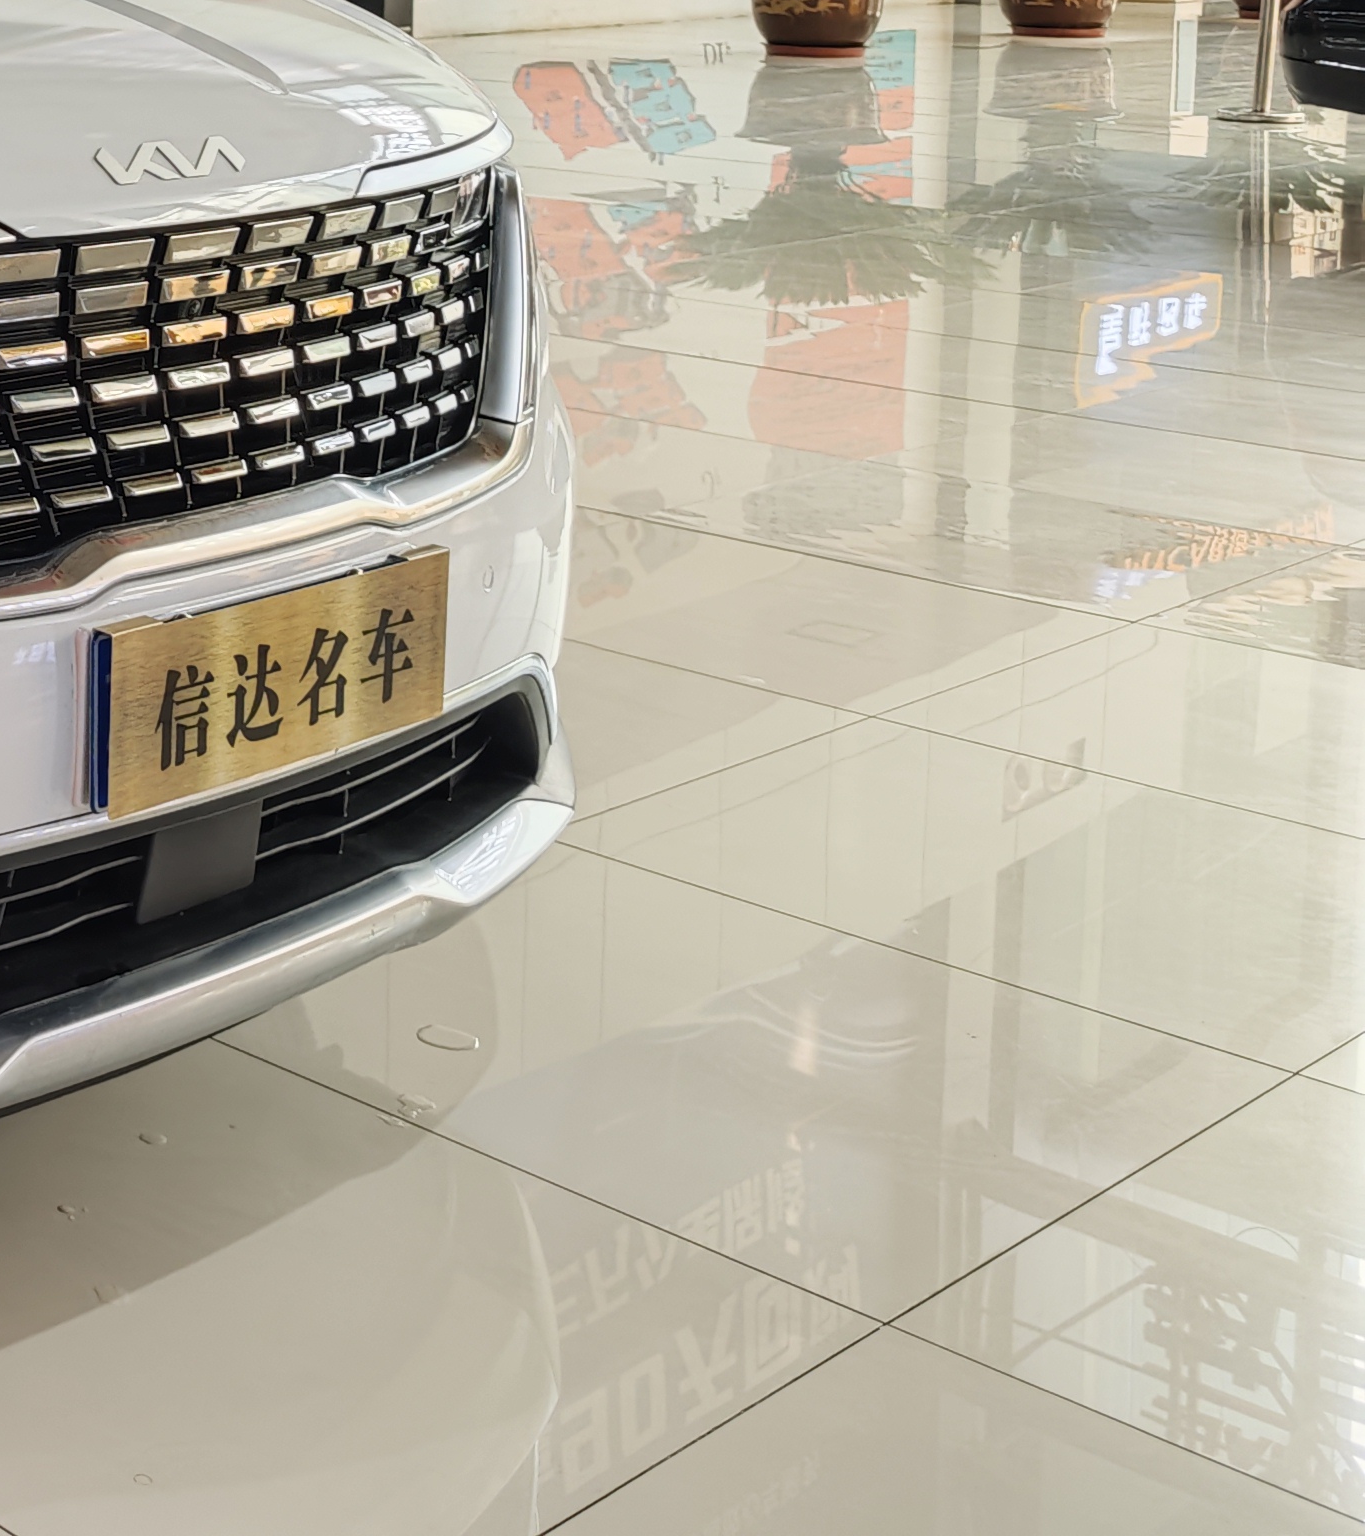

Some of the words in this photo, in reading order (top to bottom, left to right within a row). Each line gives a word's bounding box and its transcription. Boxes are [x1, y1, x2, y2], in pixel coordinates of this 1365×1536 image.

[94, 135, 247, 187] KIA
[154, 607, 416, 772] 信达名车
